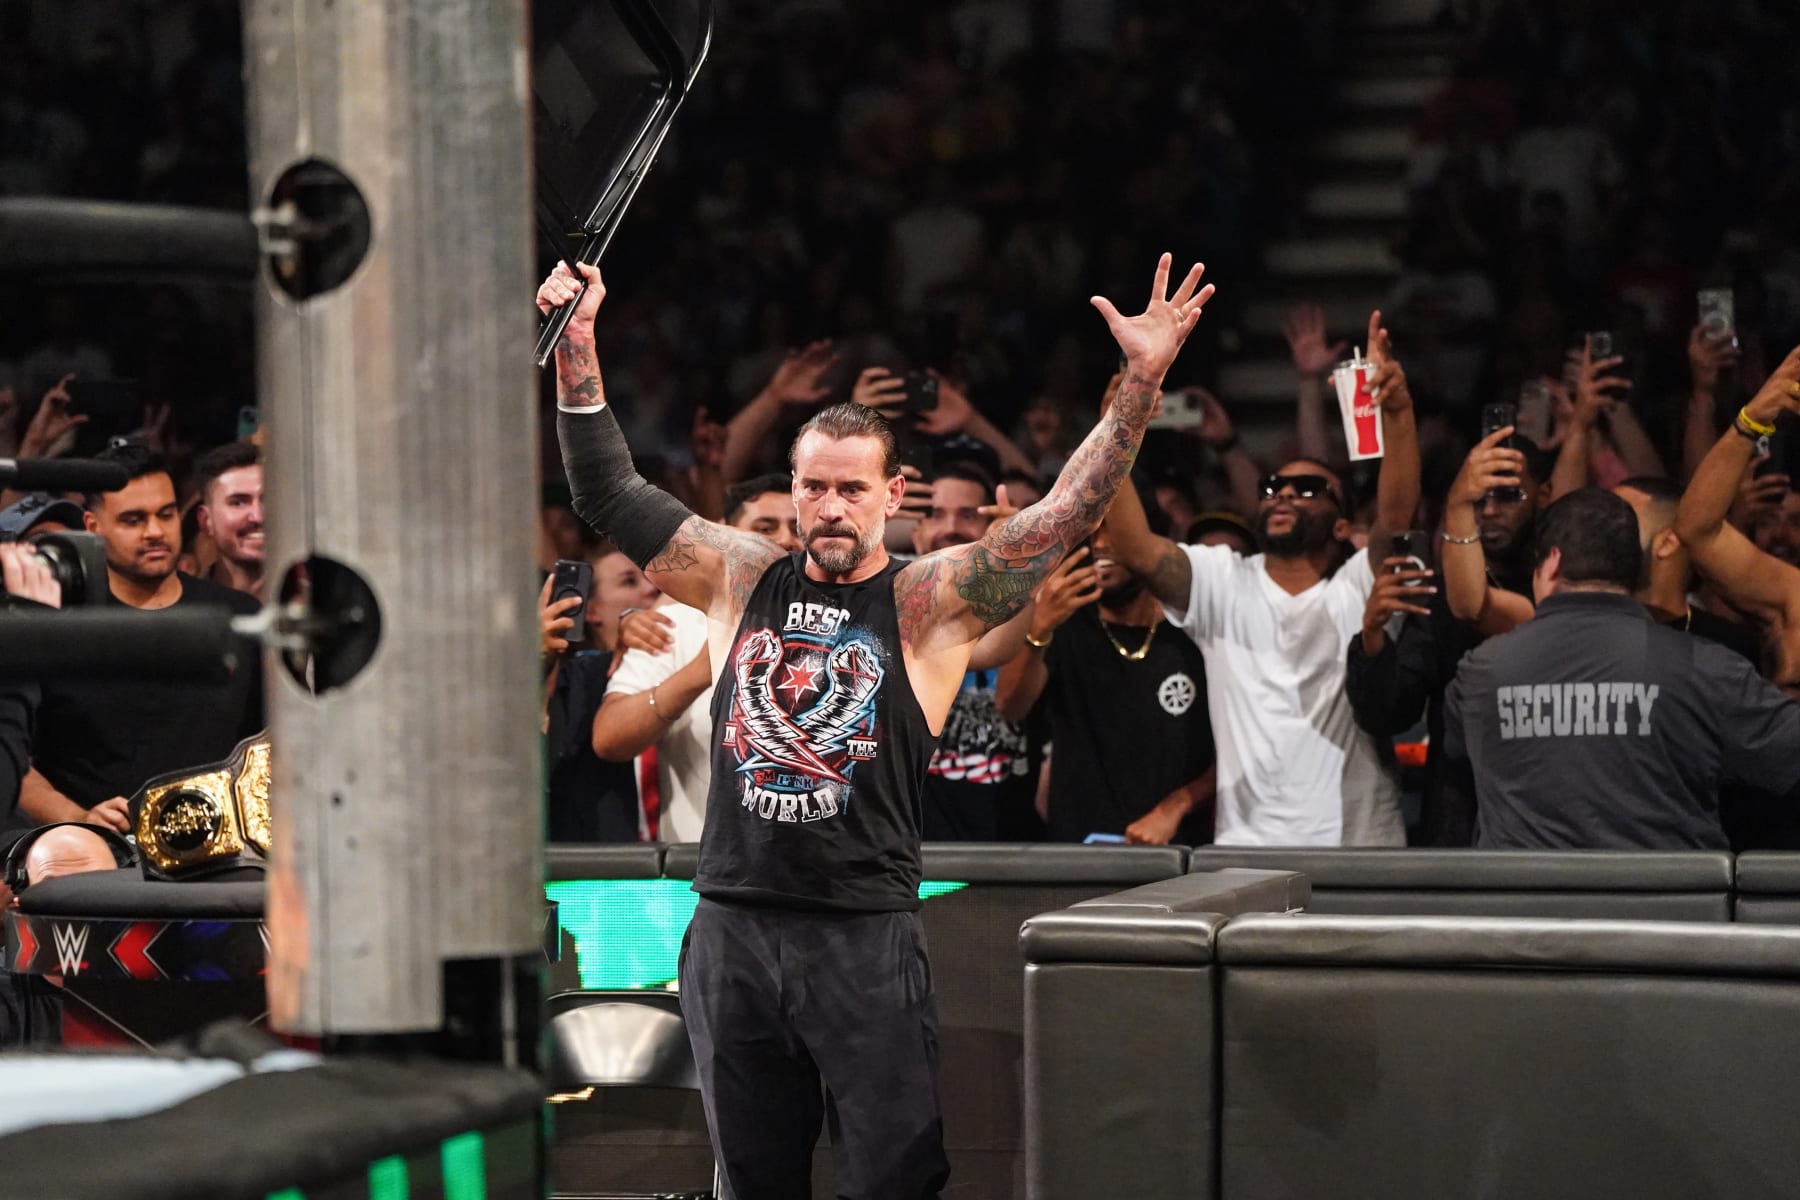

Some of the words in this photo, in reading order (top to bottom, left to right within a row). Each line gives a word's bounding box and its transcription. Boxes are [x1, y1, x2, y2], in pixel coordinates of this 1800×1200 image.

[783, 602, 851, 635] BEST
[1497, 682, 1660, 740] SECURITY
[846, 739, 878, 758] THE
[741, 777, 838, 823] WORLD
